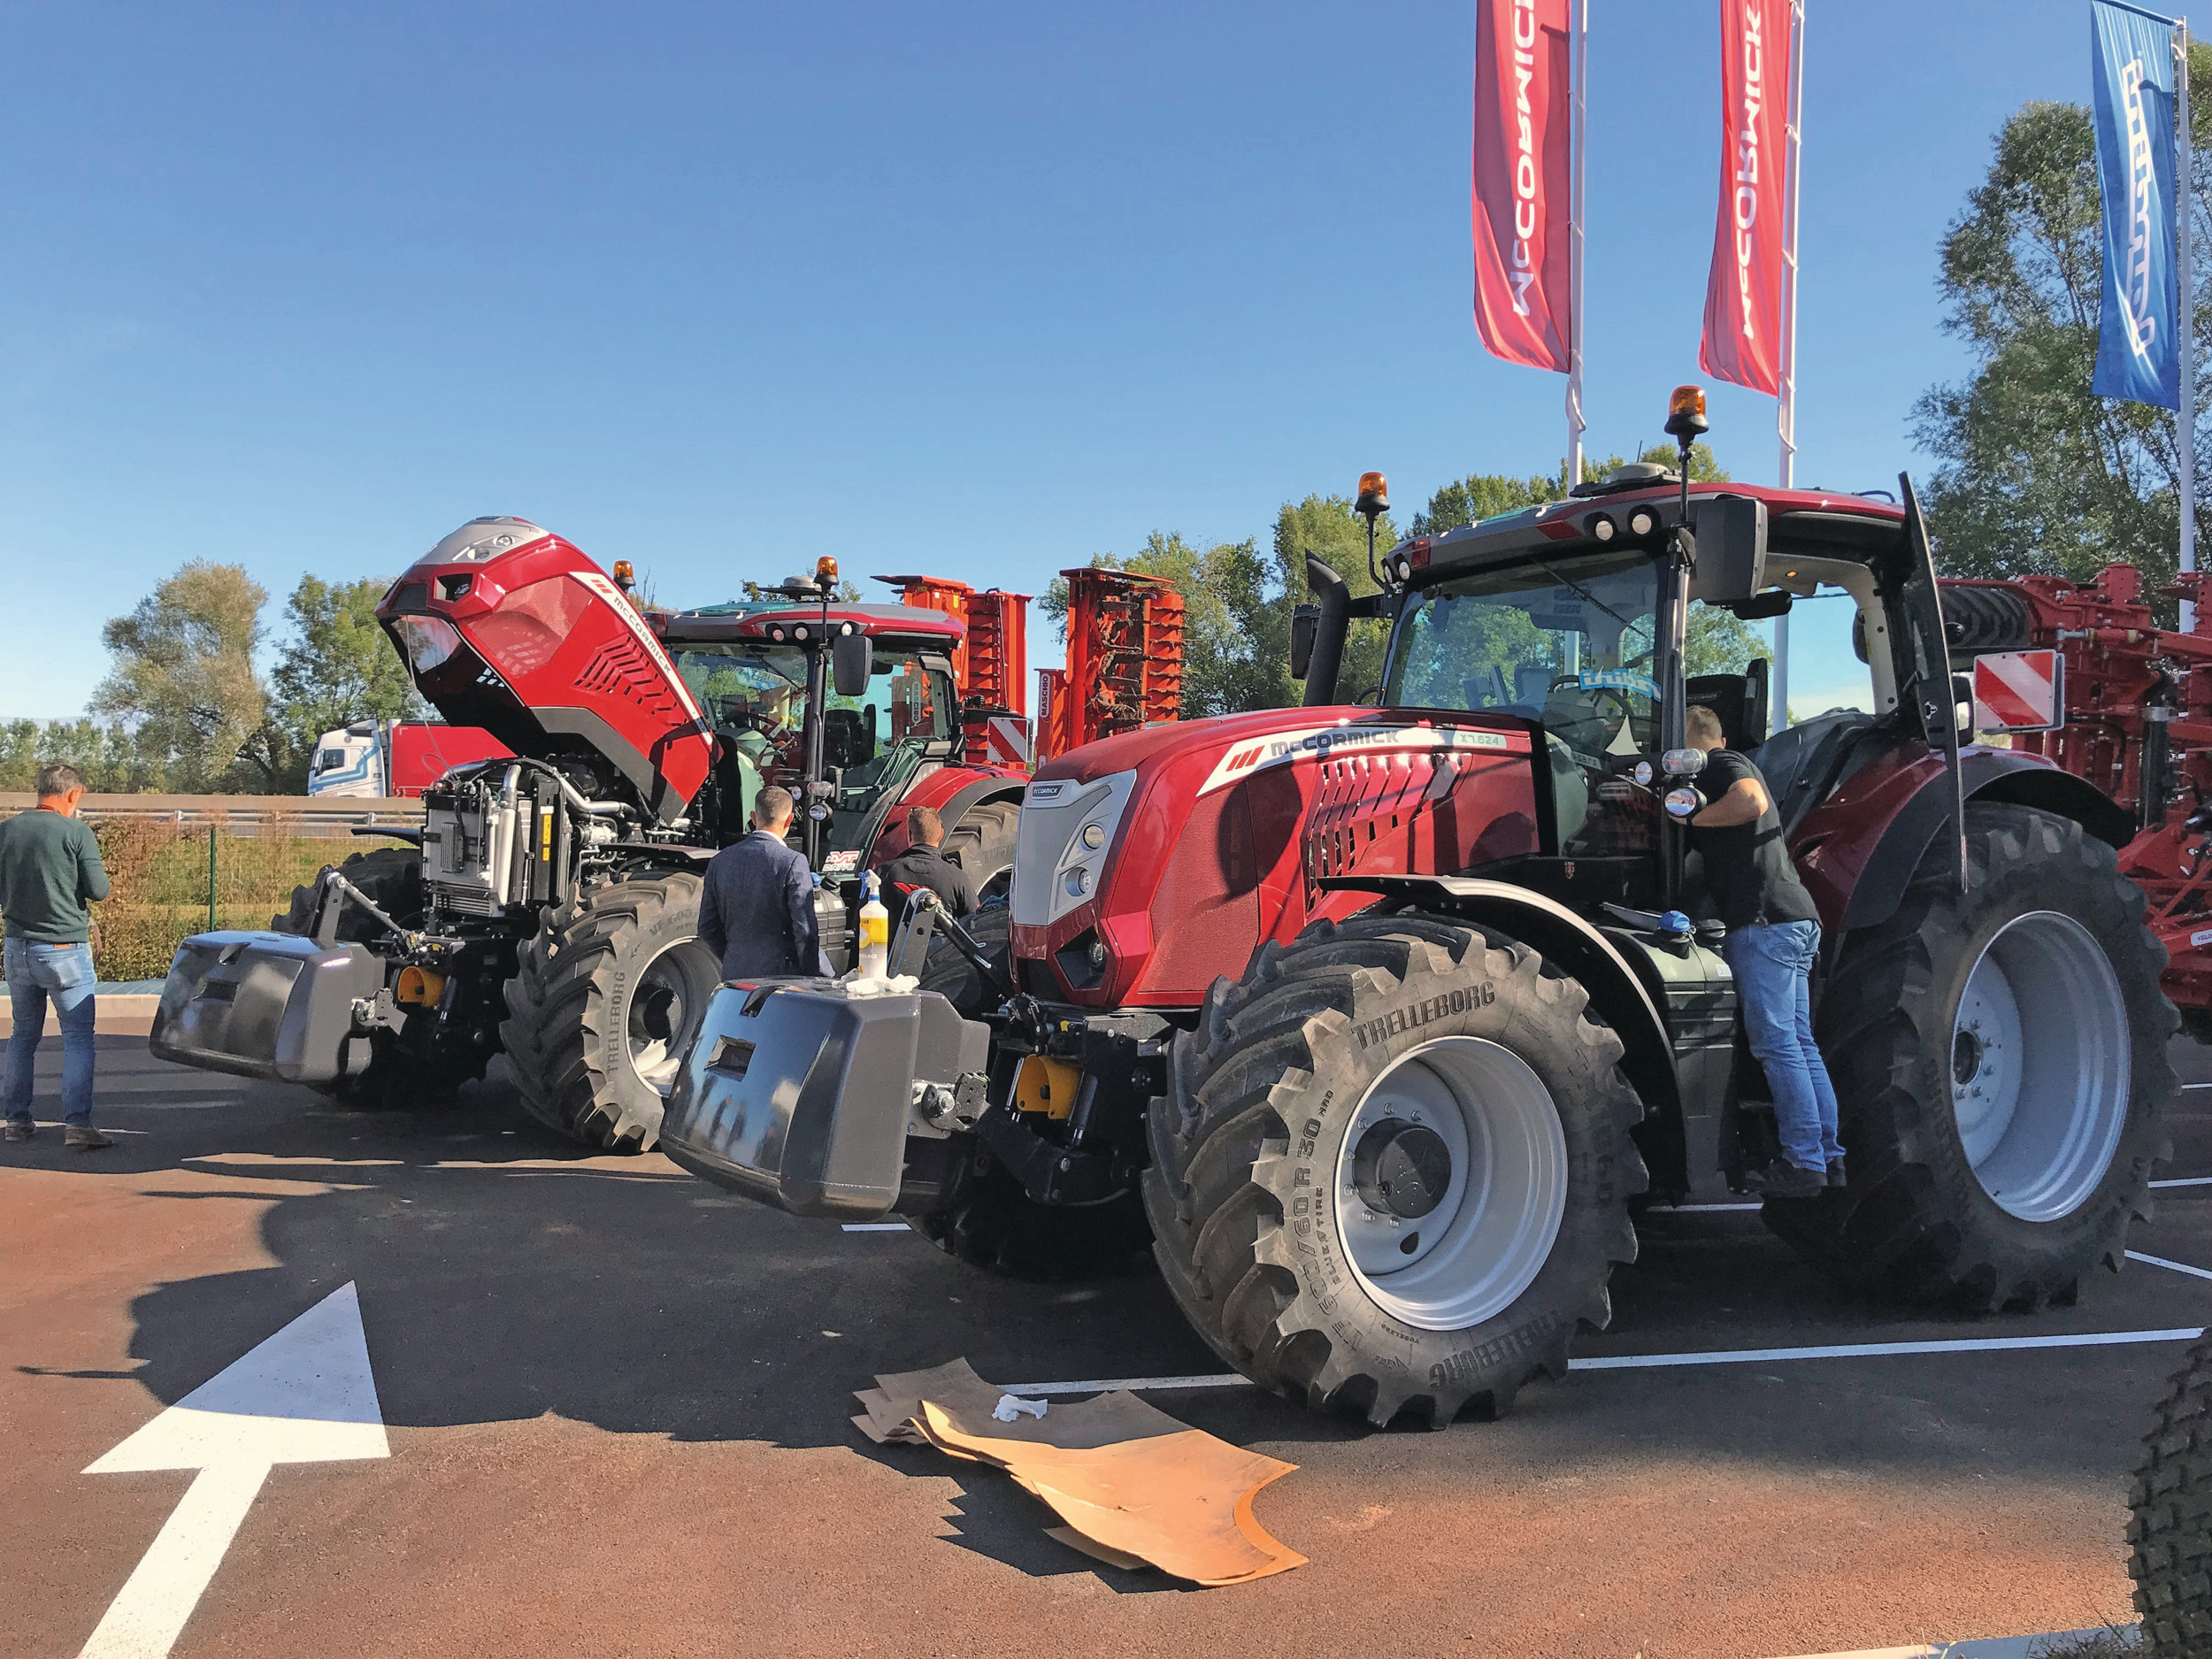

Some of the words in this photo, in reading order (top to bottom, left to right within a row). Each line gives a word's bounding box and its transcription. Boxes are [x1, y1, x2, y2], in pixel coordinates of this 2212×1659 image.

[613, 595, 672, 674] McCORMICK
[1271, 729, 1399, 757] McCORMICK
[1460, 733, 1500, 746] X7.624
[606, 972, 626, 1073] TRELLEBORG
[1351, 980, 1496, 1051] TRELLEBORG
[1297, 1118, 1321, 1161] 30
[1294, 1166, 1310, 1187] R
[1315, 1186, 1324, 1228] TIRE
